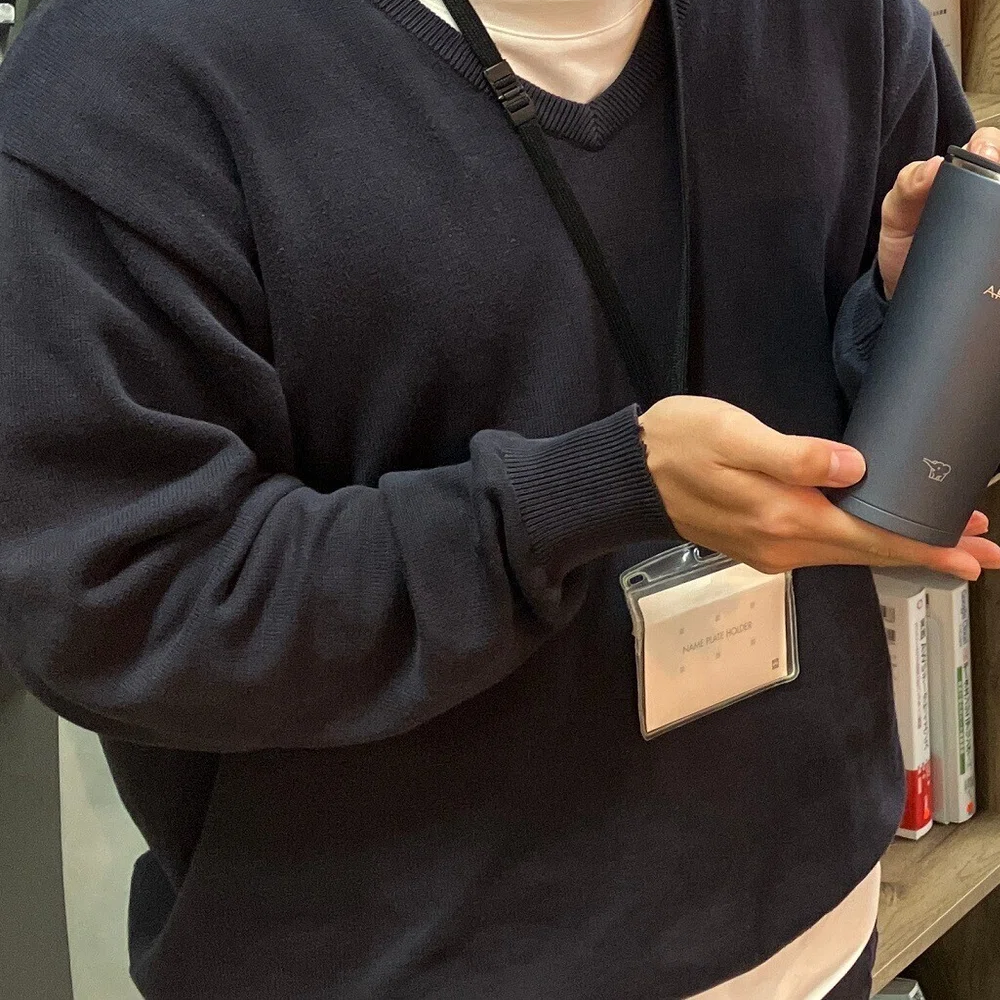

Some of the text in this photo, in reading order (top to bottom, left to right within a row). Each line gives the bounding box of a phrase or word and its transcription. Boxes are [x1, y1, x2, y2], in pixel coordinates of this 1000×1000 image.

[682, 620, 753, 654] NAME PLATE HOLDER
